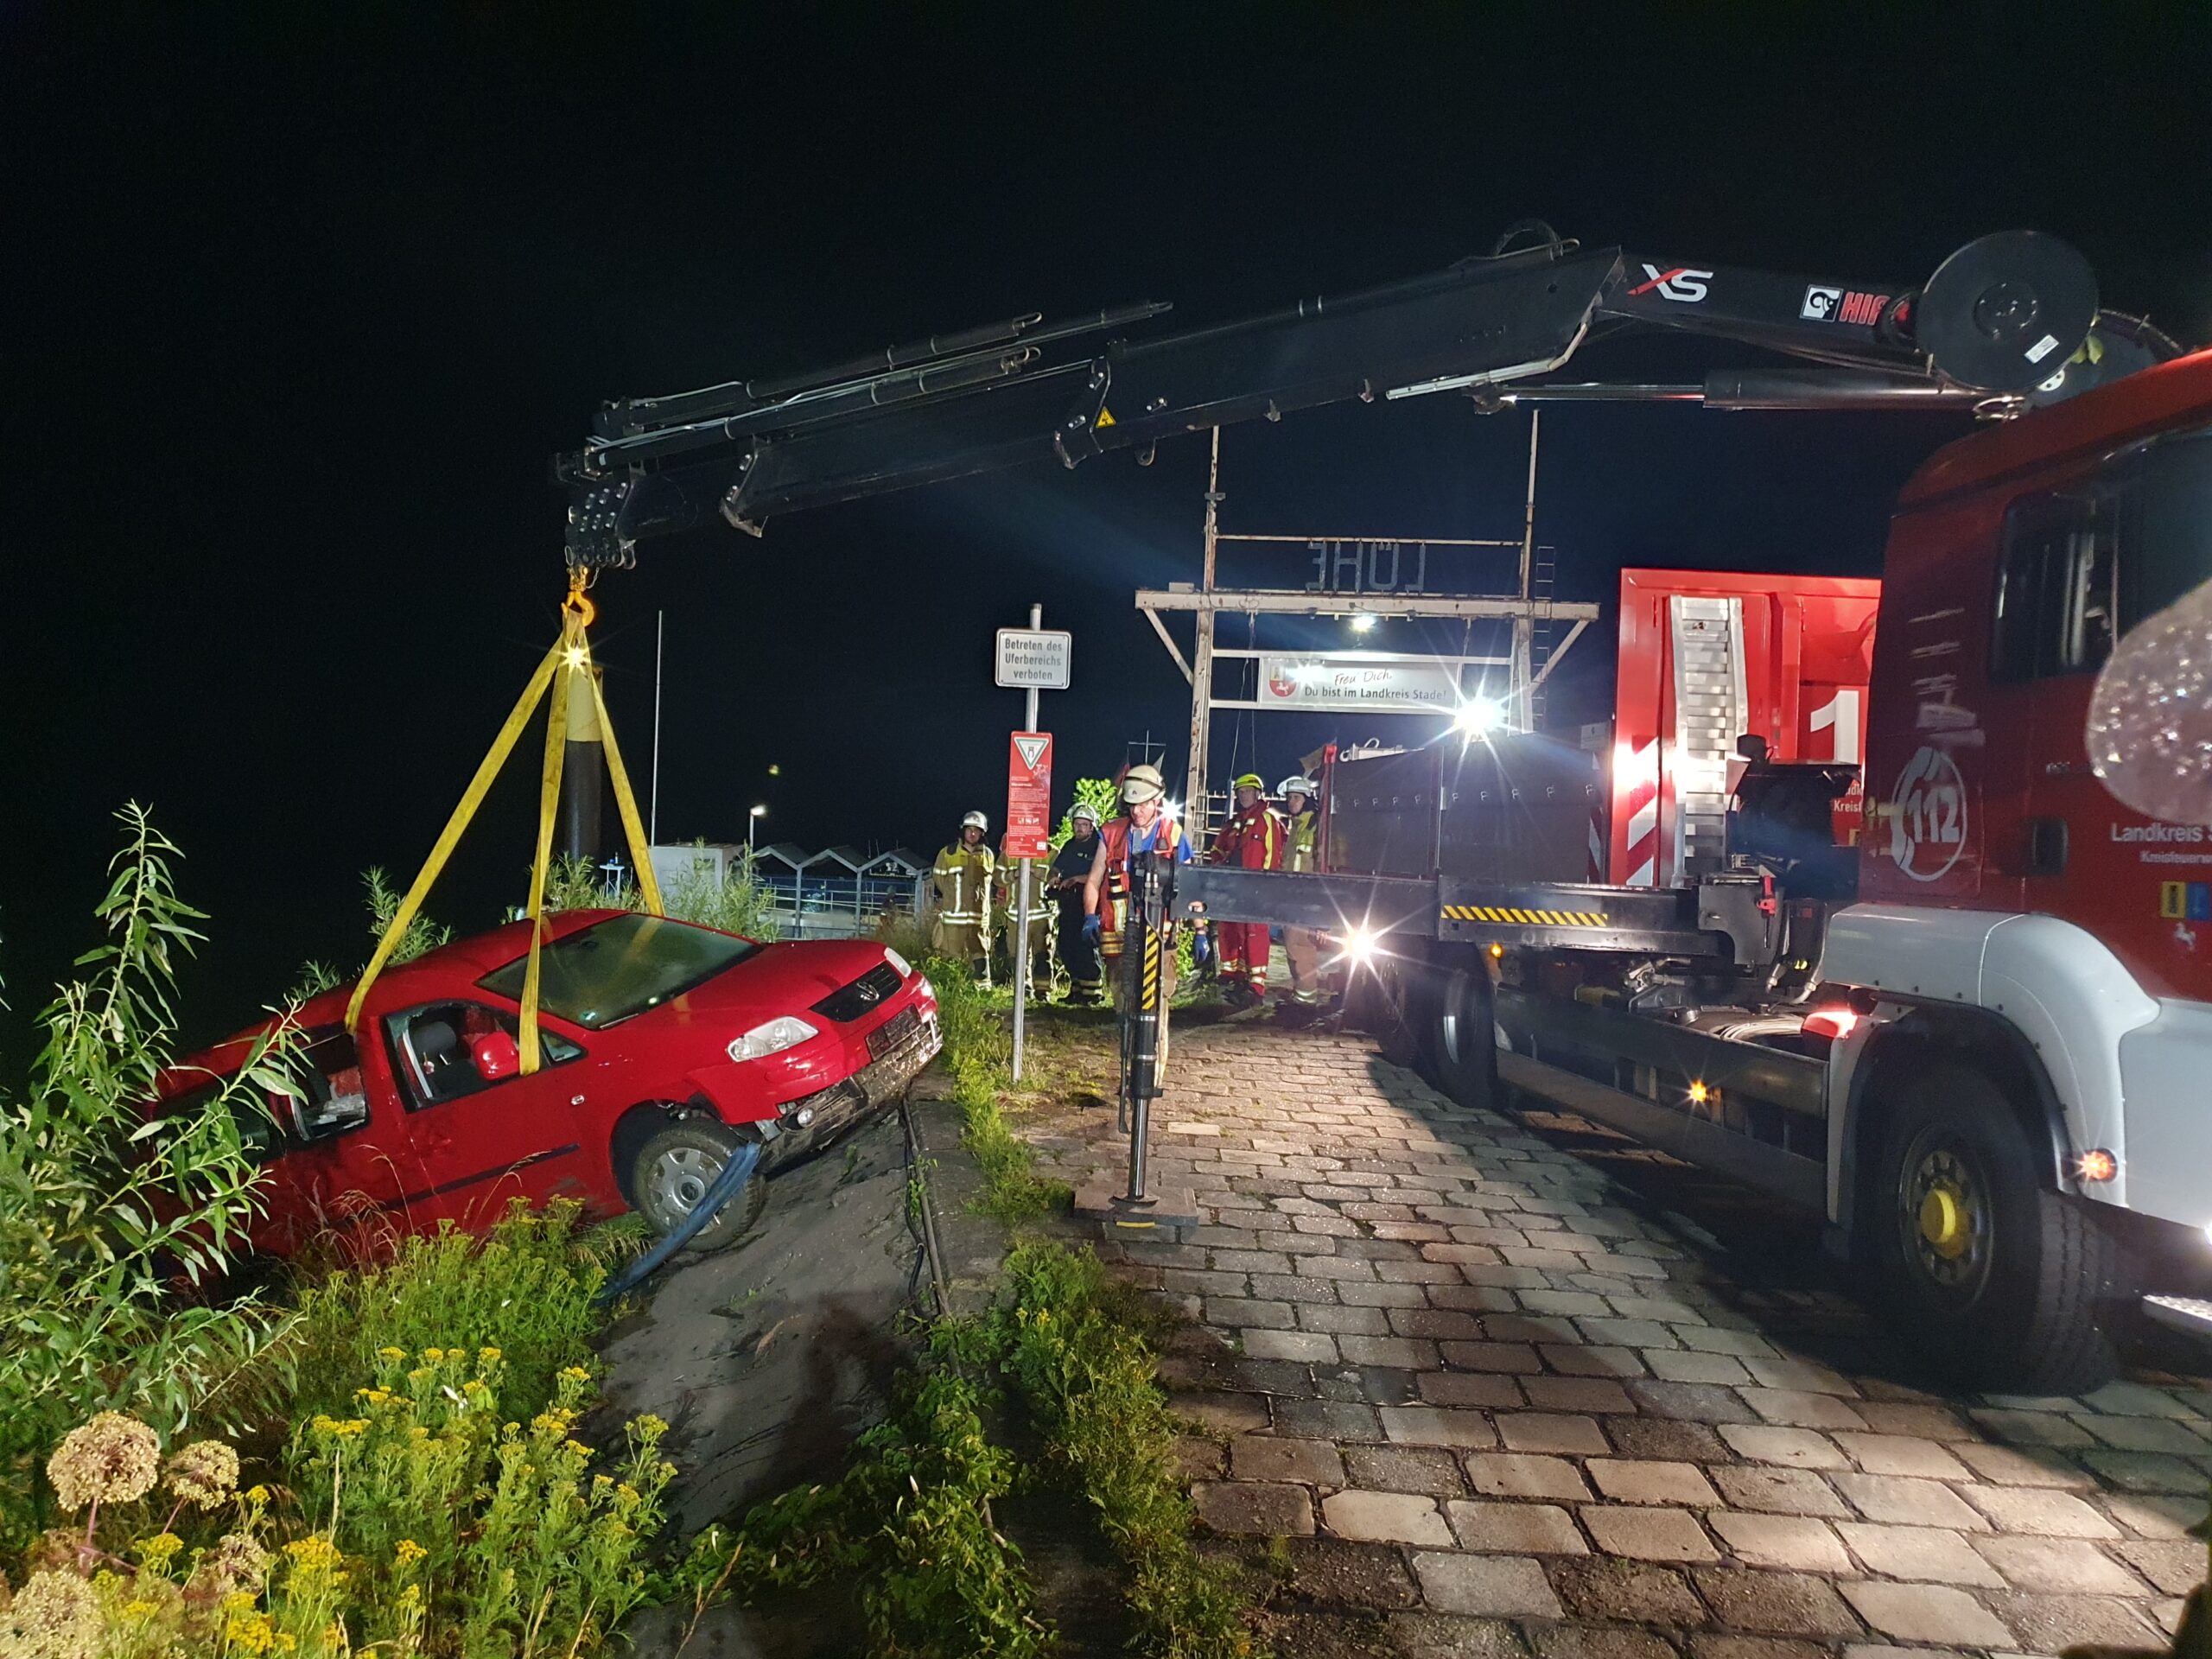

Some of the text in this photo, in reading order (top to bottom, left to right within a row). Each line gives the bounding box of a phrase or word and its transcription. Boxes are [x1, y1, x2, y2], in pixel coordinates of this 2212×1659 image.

[1627, 264, 1713, 302] XS
[1005, 638, 1063, 652] Betreten des
[1005, 652, 1062, 666] Uferbereichs
[1013, 669, 1052, 680] verboten
[1304, 686, 1319, 697] Du
[1322, 687, 1341, 697] bist
[1344, 687, 1357, 698] im
[1361, 688, 1409, 699] Landkreis
[1906, 785, 1961, 843] 112
[2111, 823, 2203, 842] Landkreis
